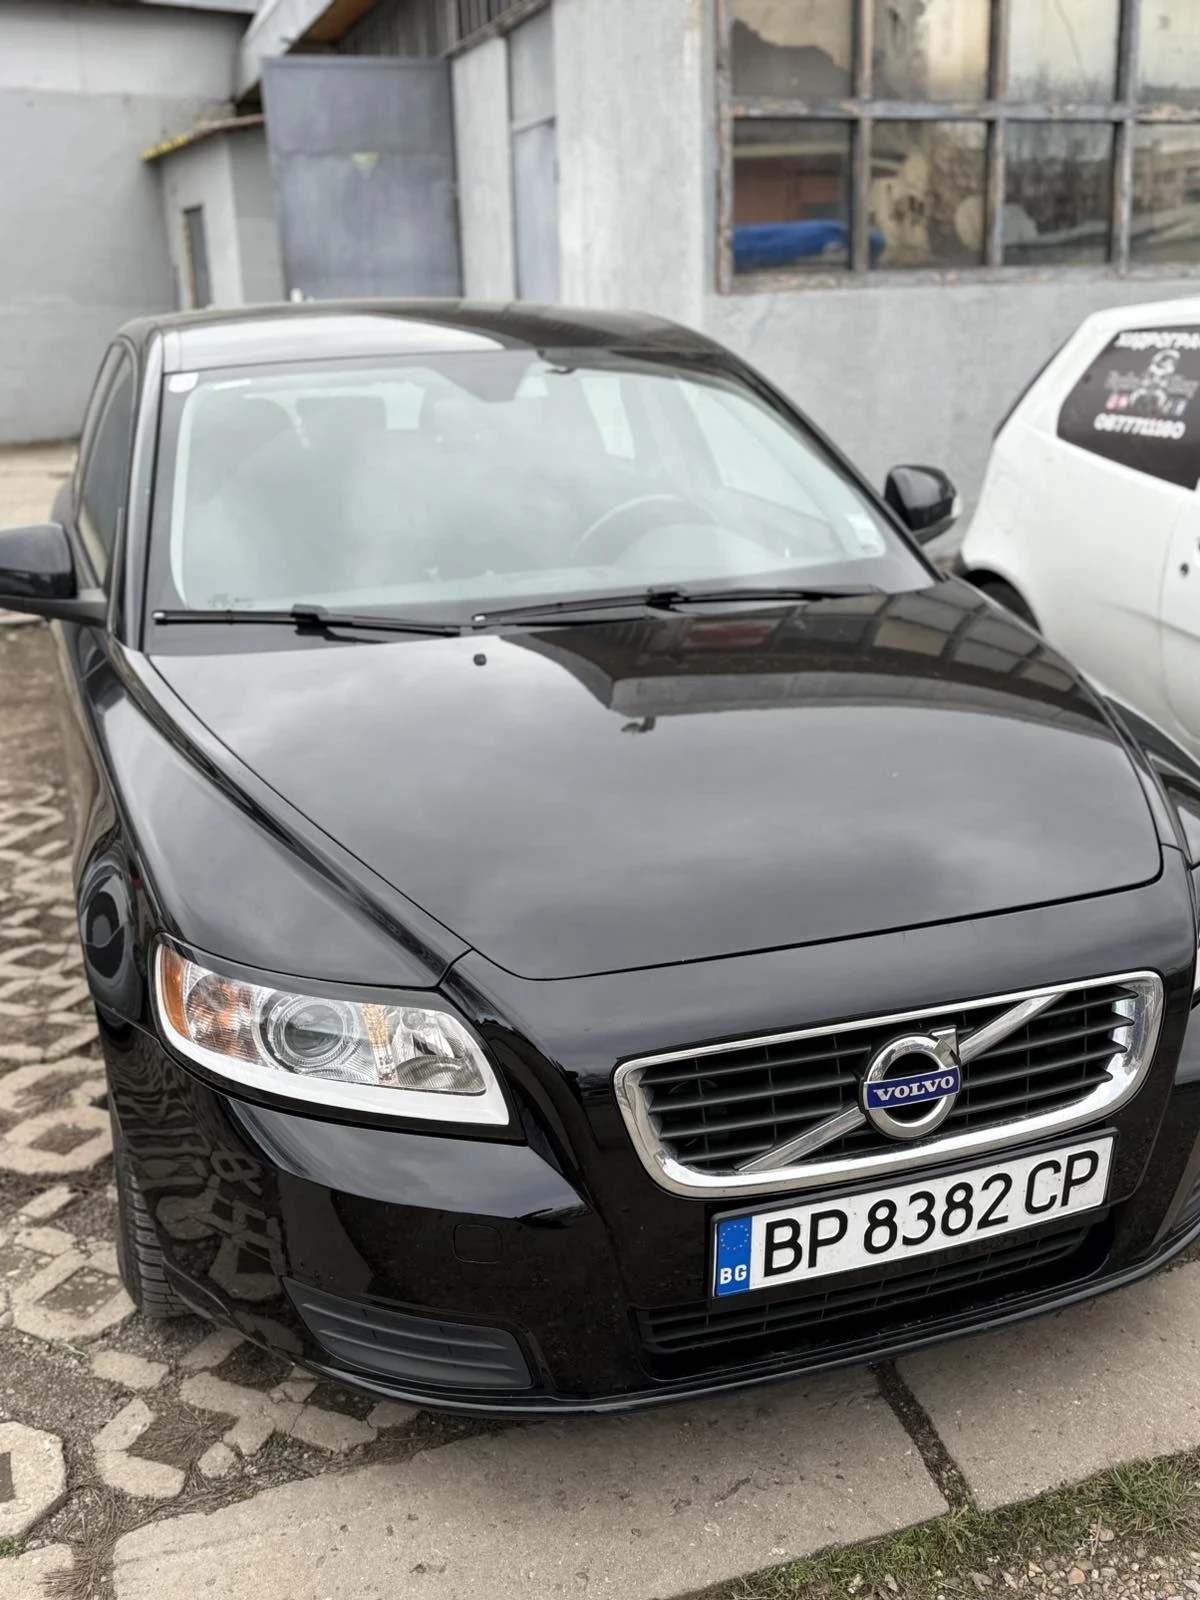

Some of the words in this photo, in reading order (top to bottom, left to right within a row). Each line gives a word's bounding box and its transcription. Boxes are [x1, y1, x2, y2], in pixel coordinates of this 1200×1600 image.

[873, 1076, 954, 1101] VOLVO
[763, 1209, 848, 1278] BP
[863, 1172, 1013, 1255] 8382
[1025, 1149, 1099, 1215] CP
[719, 1265, 747, 1285] BG
